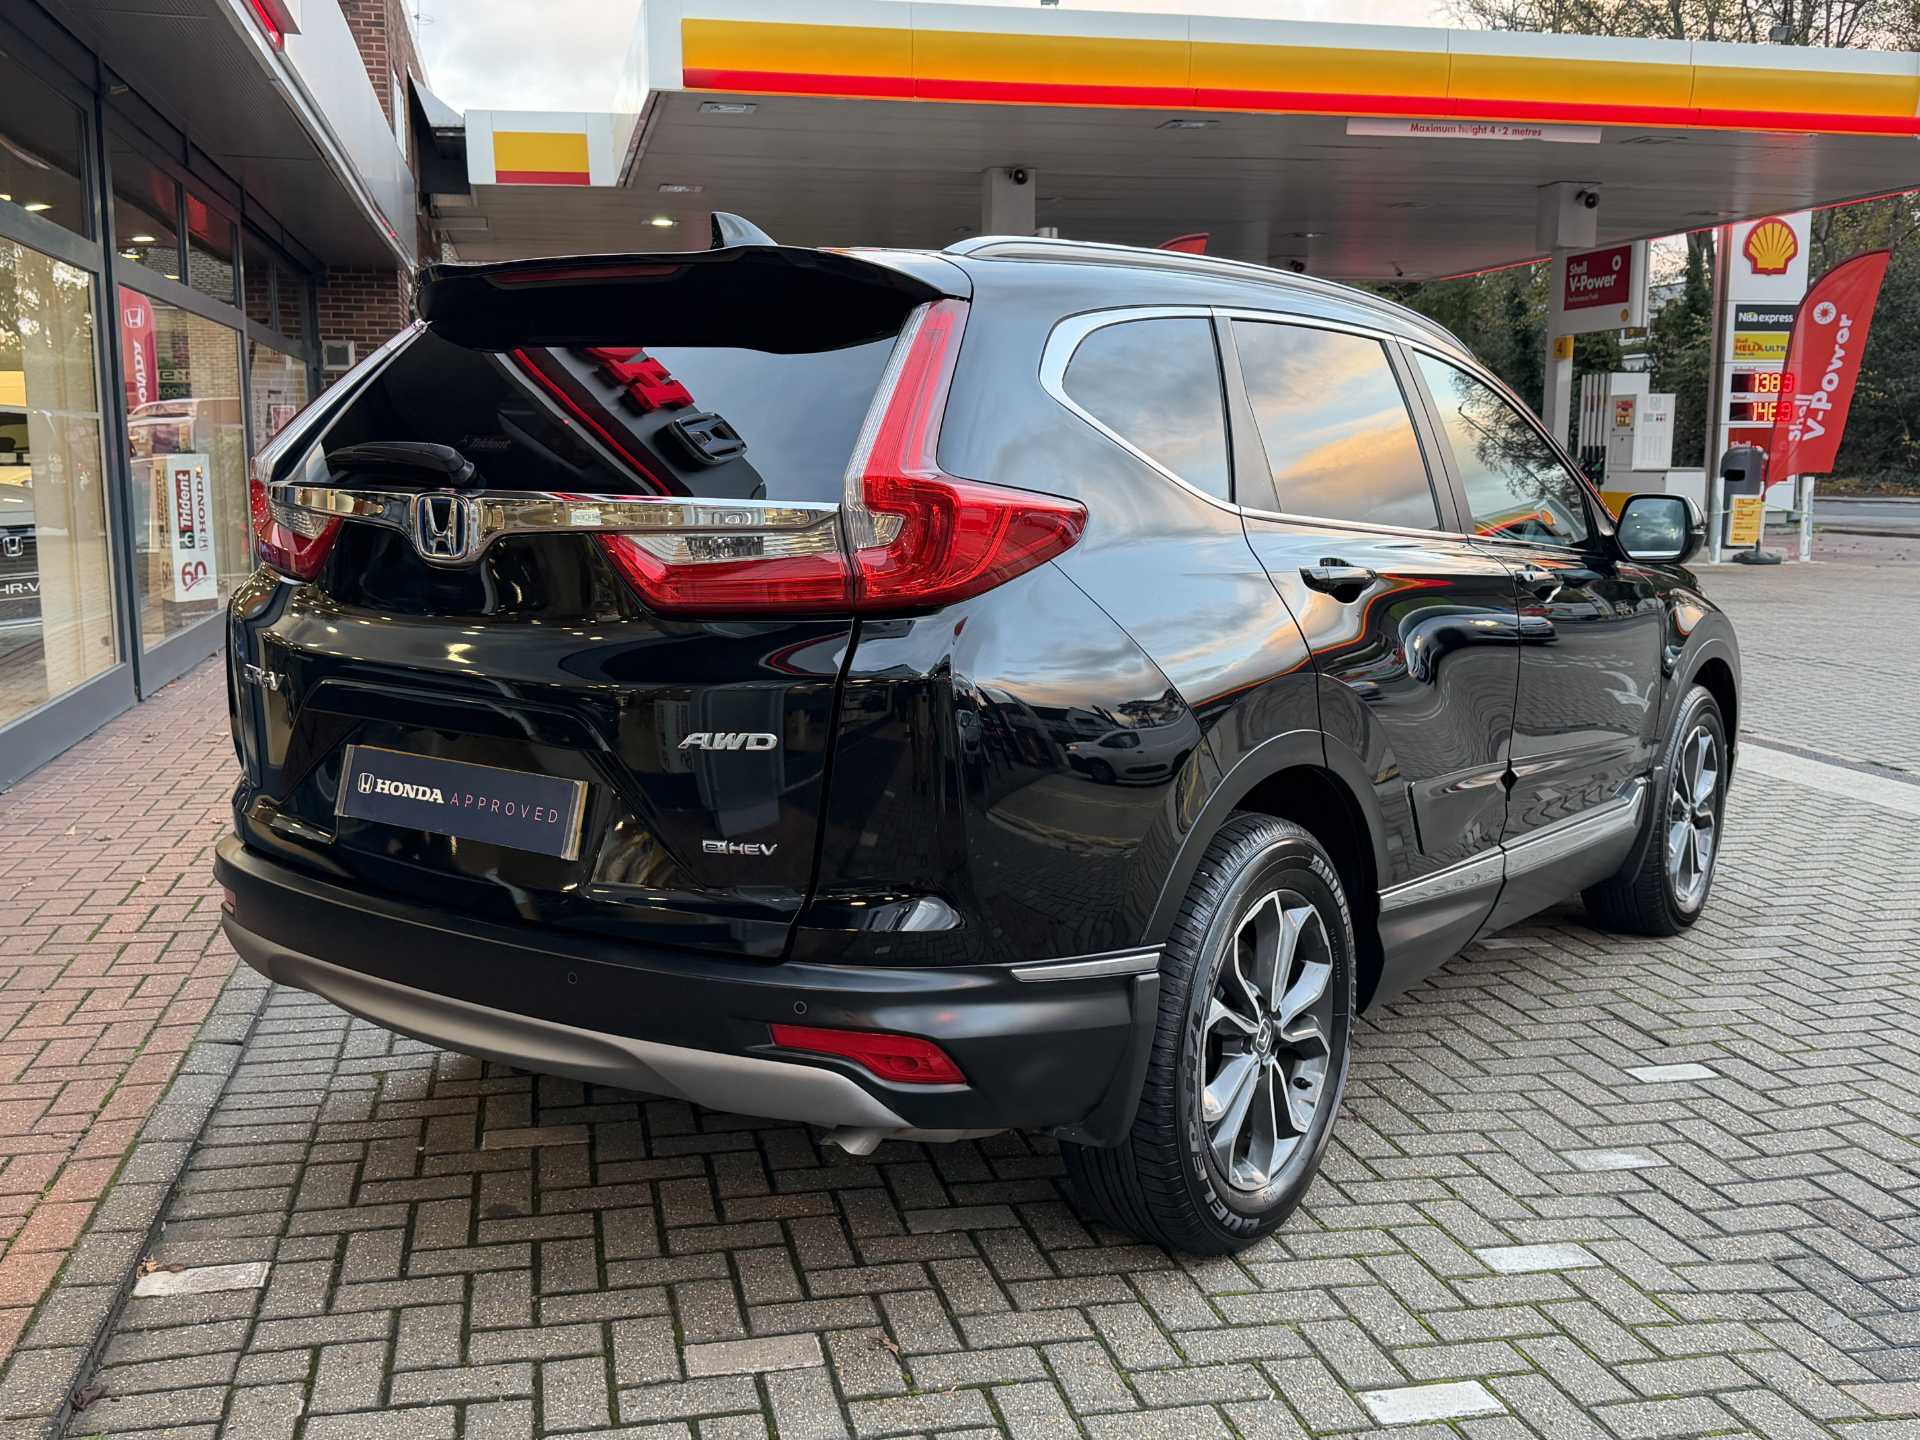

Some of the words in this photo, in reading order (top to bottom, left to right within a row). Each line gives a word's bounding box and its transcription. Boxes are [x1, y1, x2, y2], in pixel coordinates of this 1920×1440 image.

[1410, 122, 1455, 134] Maximum
[1457, 124, 1487, 136] height
[1511, 127, 1543, 137] metres
[1569, 261, 1588, 276] Shell
[1569, 274, 1617, 292] V-Power
[1758, 312, 1794, 325] express
[1764, 344, 1786, 353] ULTR
[1802, 313, 1853, 441] V-Power
[1788, 393, 1814, 442] Shell
[176, 472, 193, 531] Trident
[678, 733, 778, 750] AWD
[375, 778, 445, 804] HONDA
[450, 792, 559, 824] APPROVED
